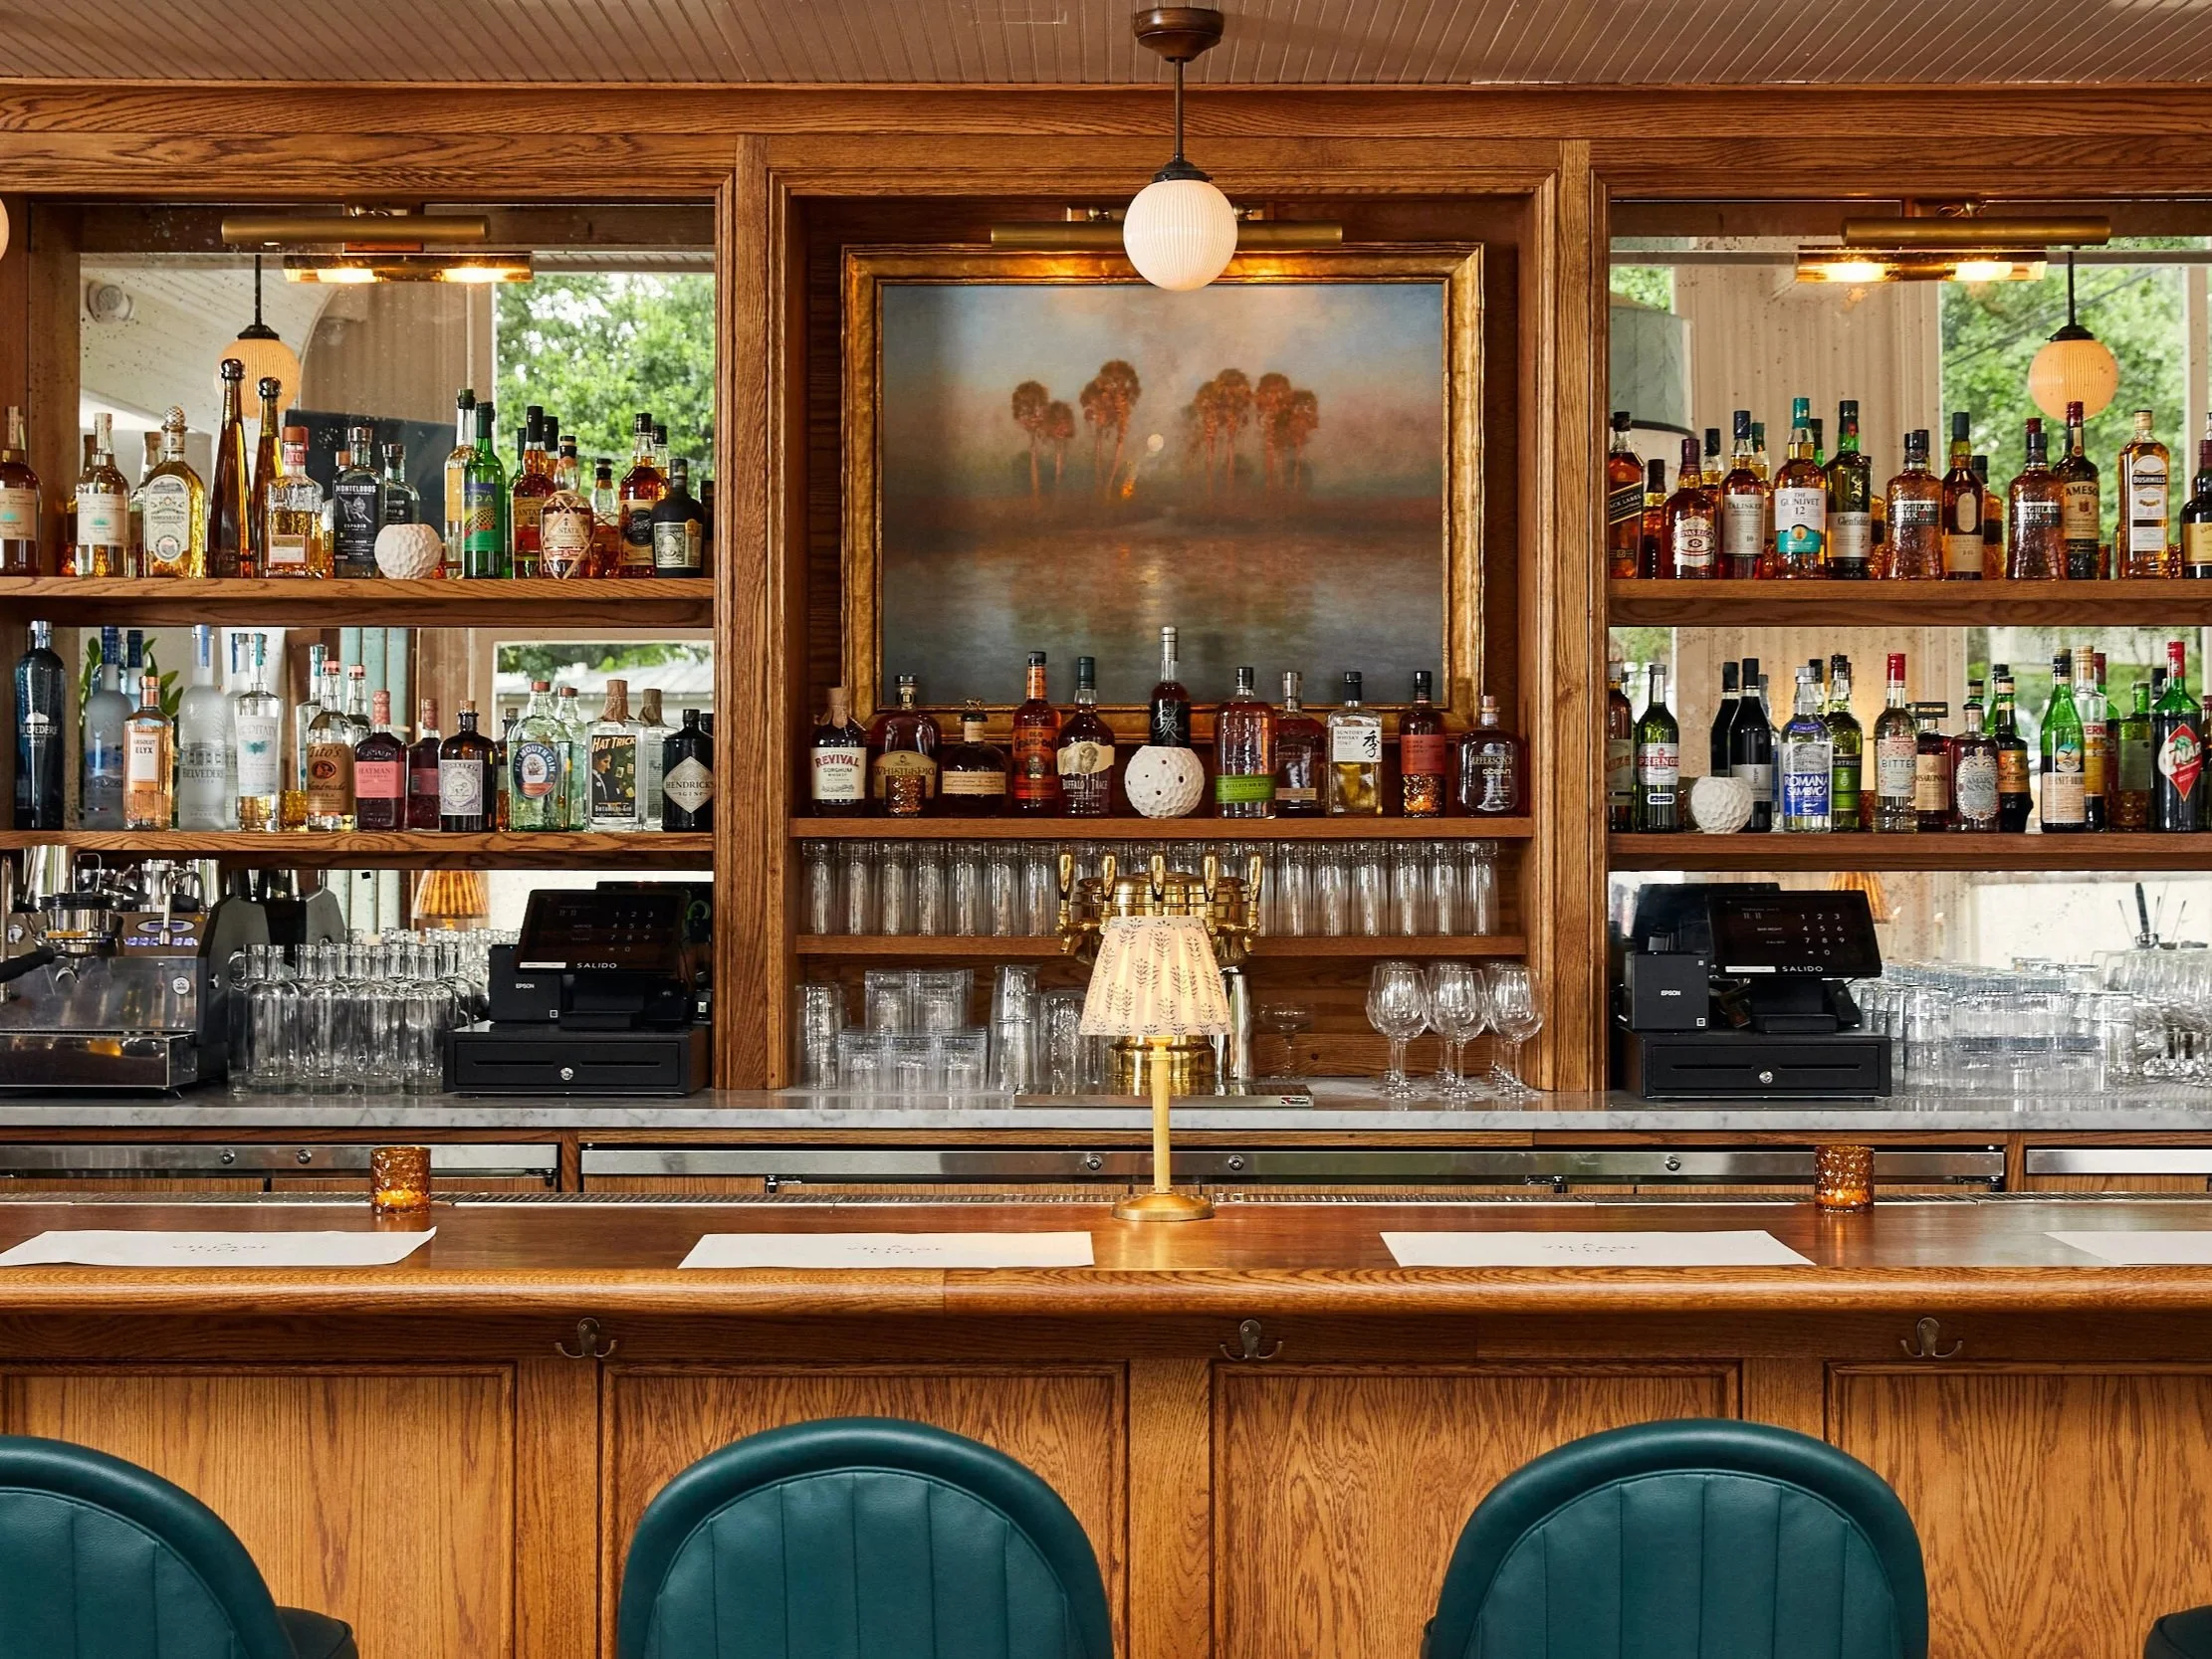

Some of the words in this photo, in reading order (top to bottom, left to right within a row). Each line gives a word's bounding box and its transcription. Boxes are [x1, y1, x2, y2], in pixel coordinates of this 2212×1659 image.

[1622, 494, 1641, 505] LABEL
[19, 724, 58, 734] BELEDERE
[591, 736, 611, 753] HAT
[611, 734, 636, 749] TRICK
[1362, 729, 1380, 758] 季
[309, 745, 342, 757] Tito's
[515, 744, 549, 772] PLYMOUTH
[546, 756, 556, 772] GIN
[815, 754, 860, 768] REVIVAL
[1062, 779, 1085, 790] BUFFALO
[1091, 779, 1107, 790] TRACE
